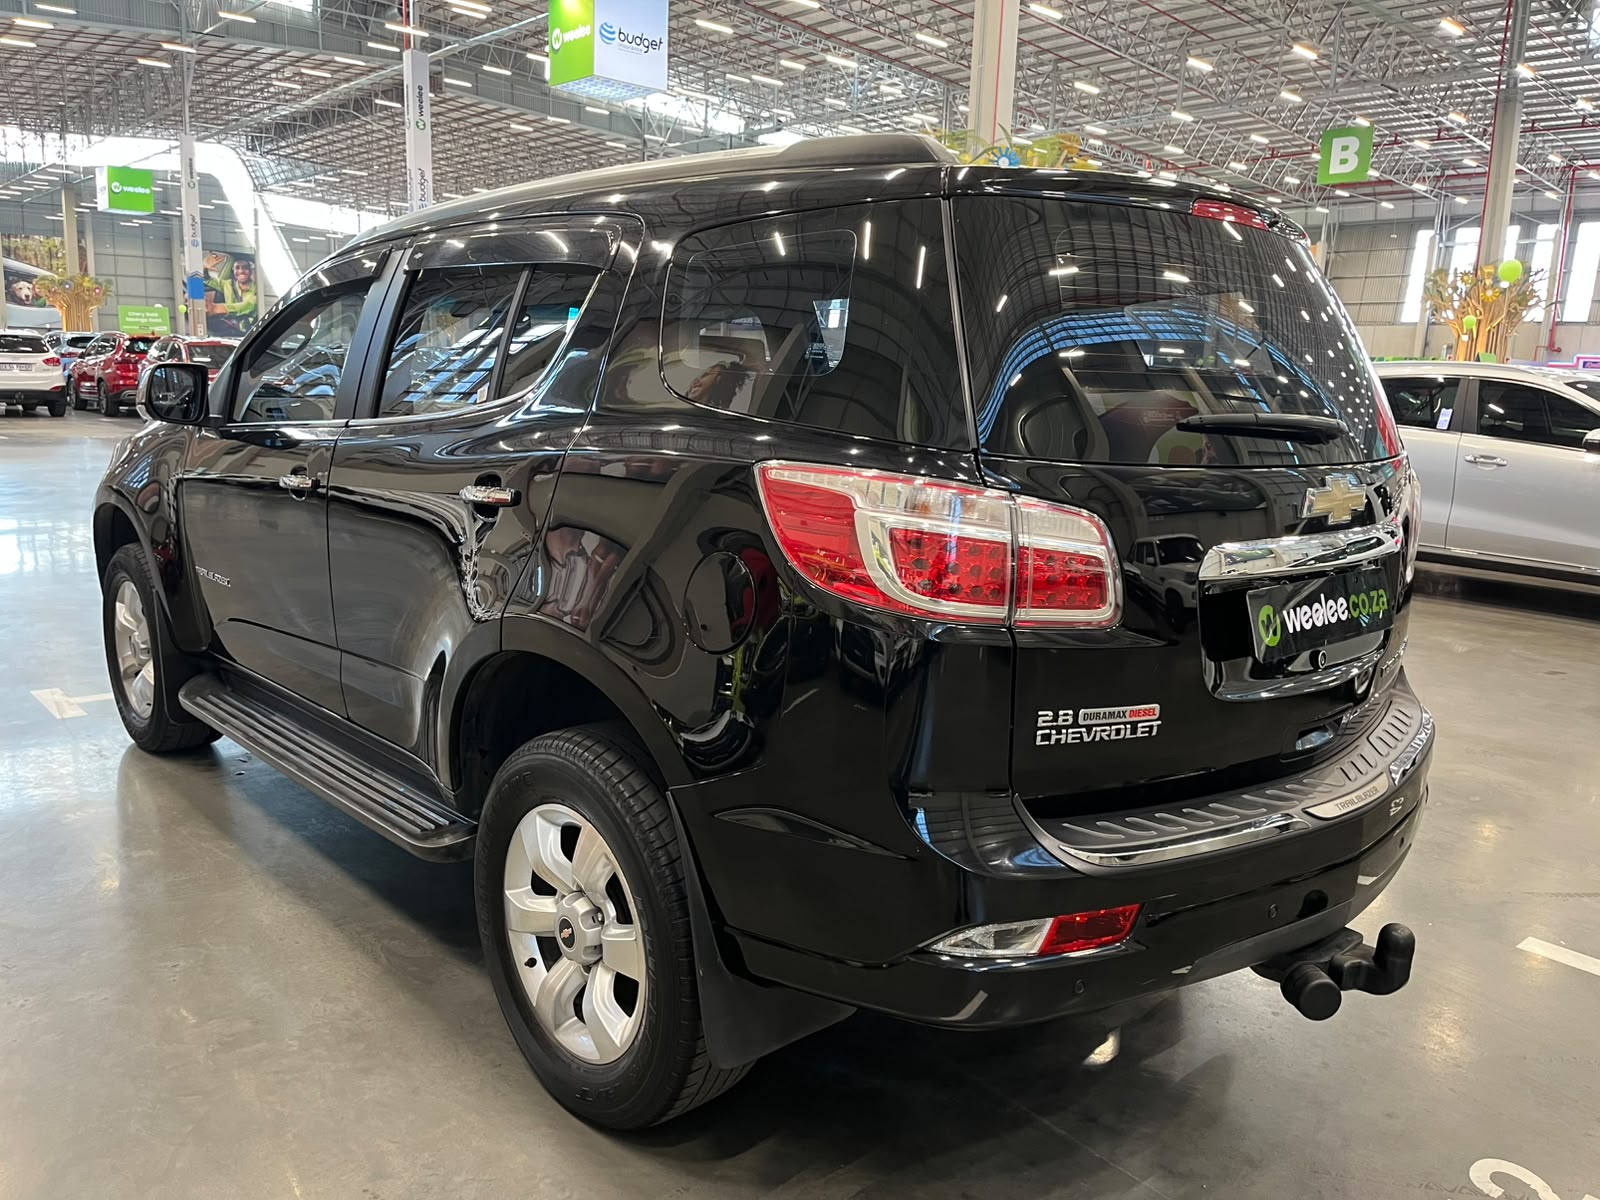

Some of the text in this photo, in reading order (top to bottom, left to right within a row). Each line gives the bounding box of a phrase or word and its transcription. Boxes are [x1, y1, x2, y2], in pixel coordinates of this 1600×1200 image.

[563, 24, 591, 43] weelee
[618, 27, 663, 53] budget
[416, 84, 425, 117] weelee
[1329, 136, 1360, 175] B
[122, 184, 151, 195] weelee
[417, 167, 430, 203] budget
[1282, 588, 1388, 634] weelee.co.za
[1036, 707, 1157, 728] 2.8 DURAMAX DIESEL
[1035, 720, 1162, 746] CHEVROLET
[1335, 785, 1380, 812] TRAILBLAZER
